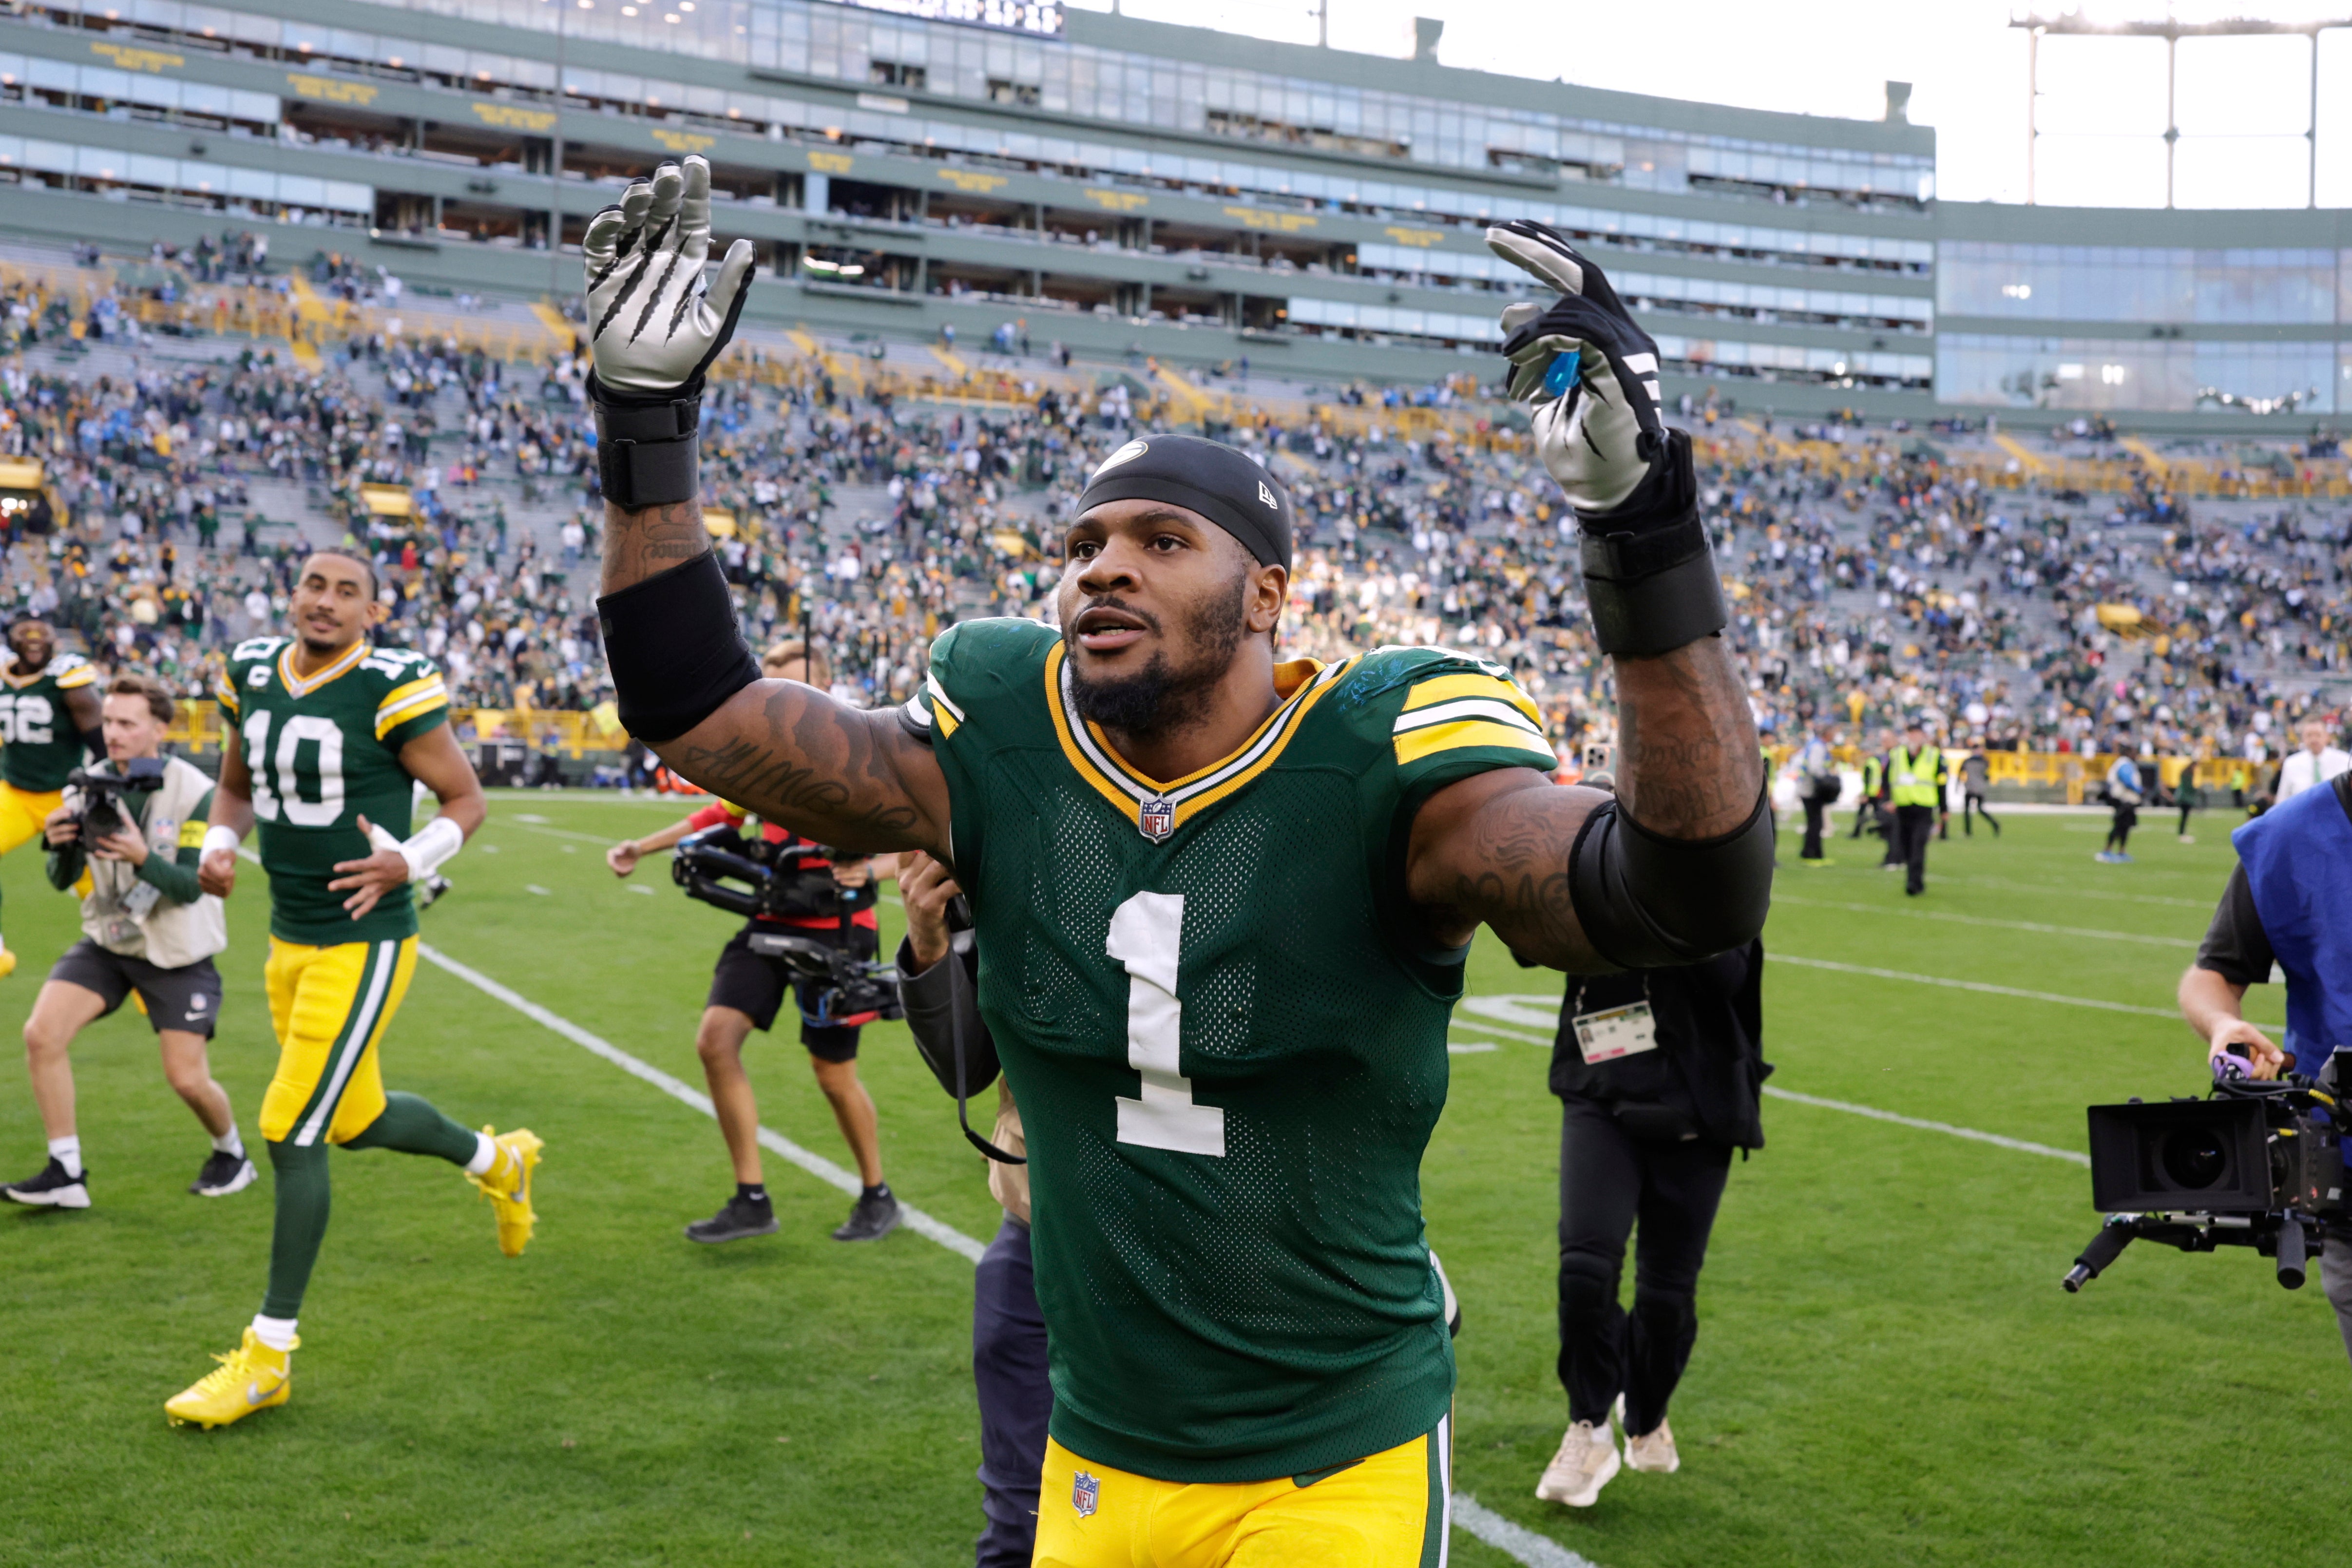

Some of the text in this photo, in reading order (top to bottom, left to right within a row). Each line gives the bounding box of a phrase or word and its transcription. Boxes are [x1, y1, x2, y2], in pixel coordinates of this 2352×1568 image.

[244, 709, 345, 826] 10
[1144, 816, 1168, 835] NFL
[1106, 890, 1225, 1158] 1
[1075, 1489, 1092, 1509] NFL
